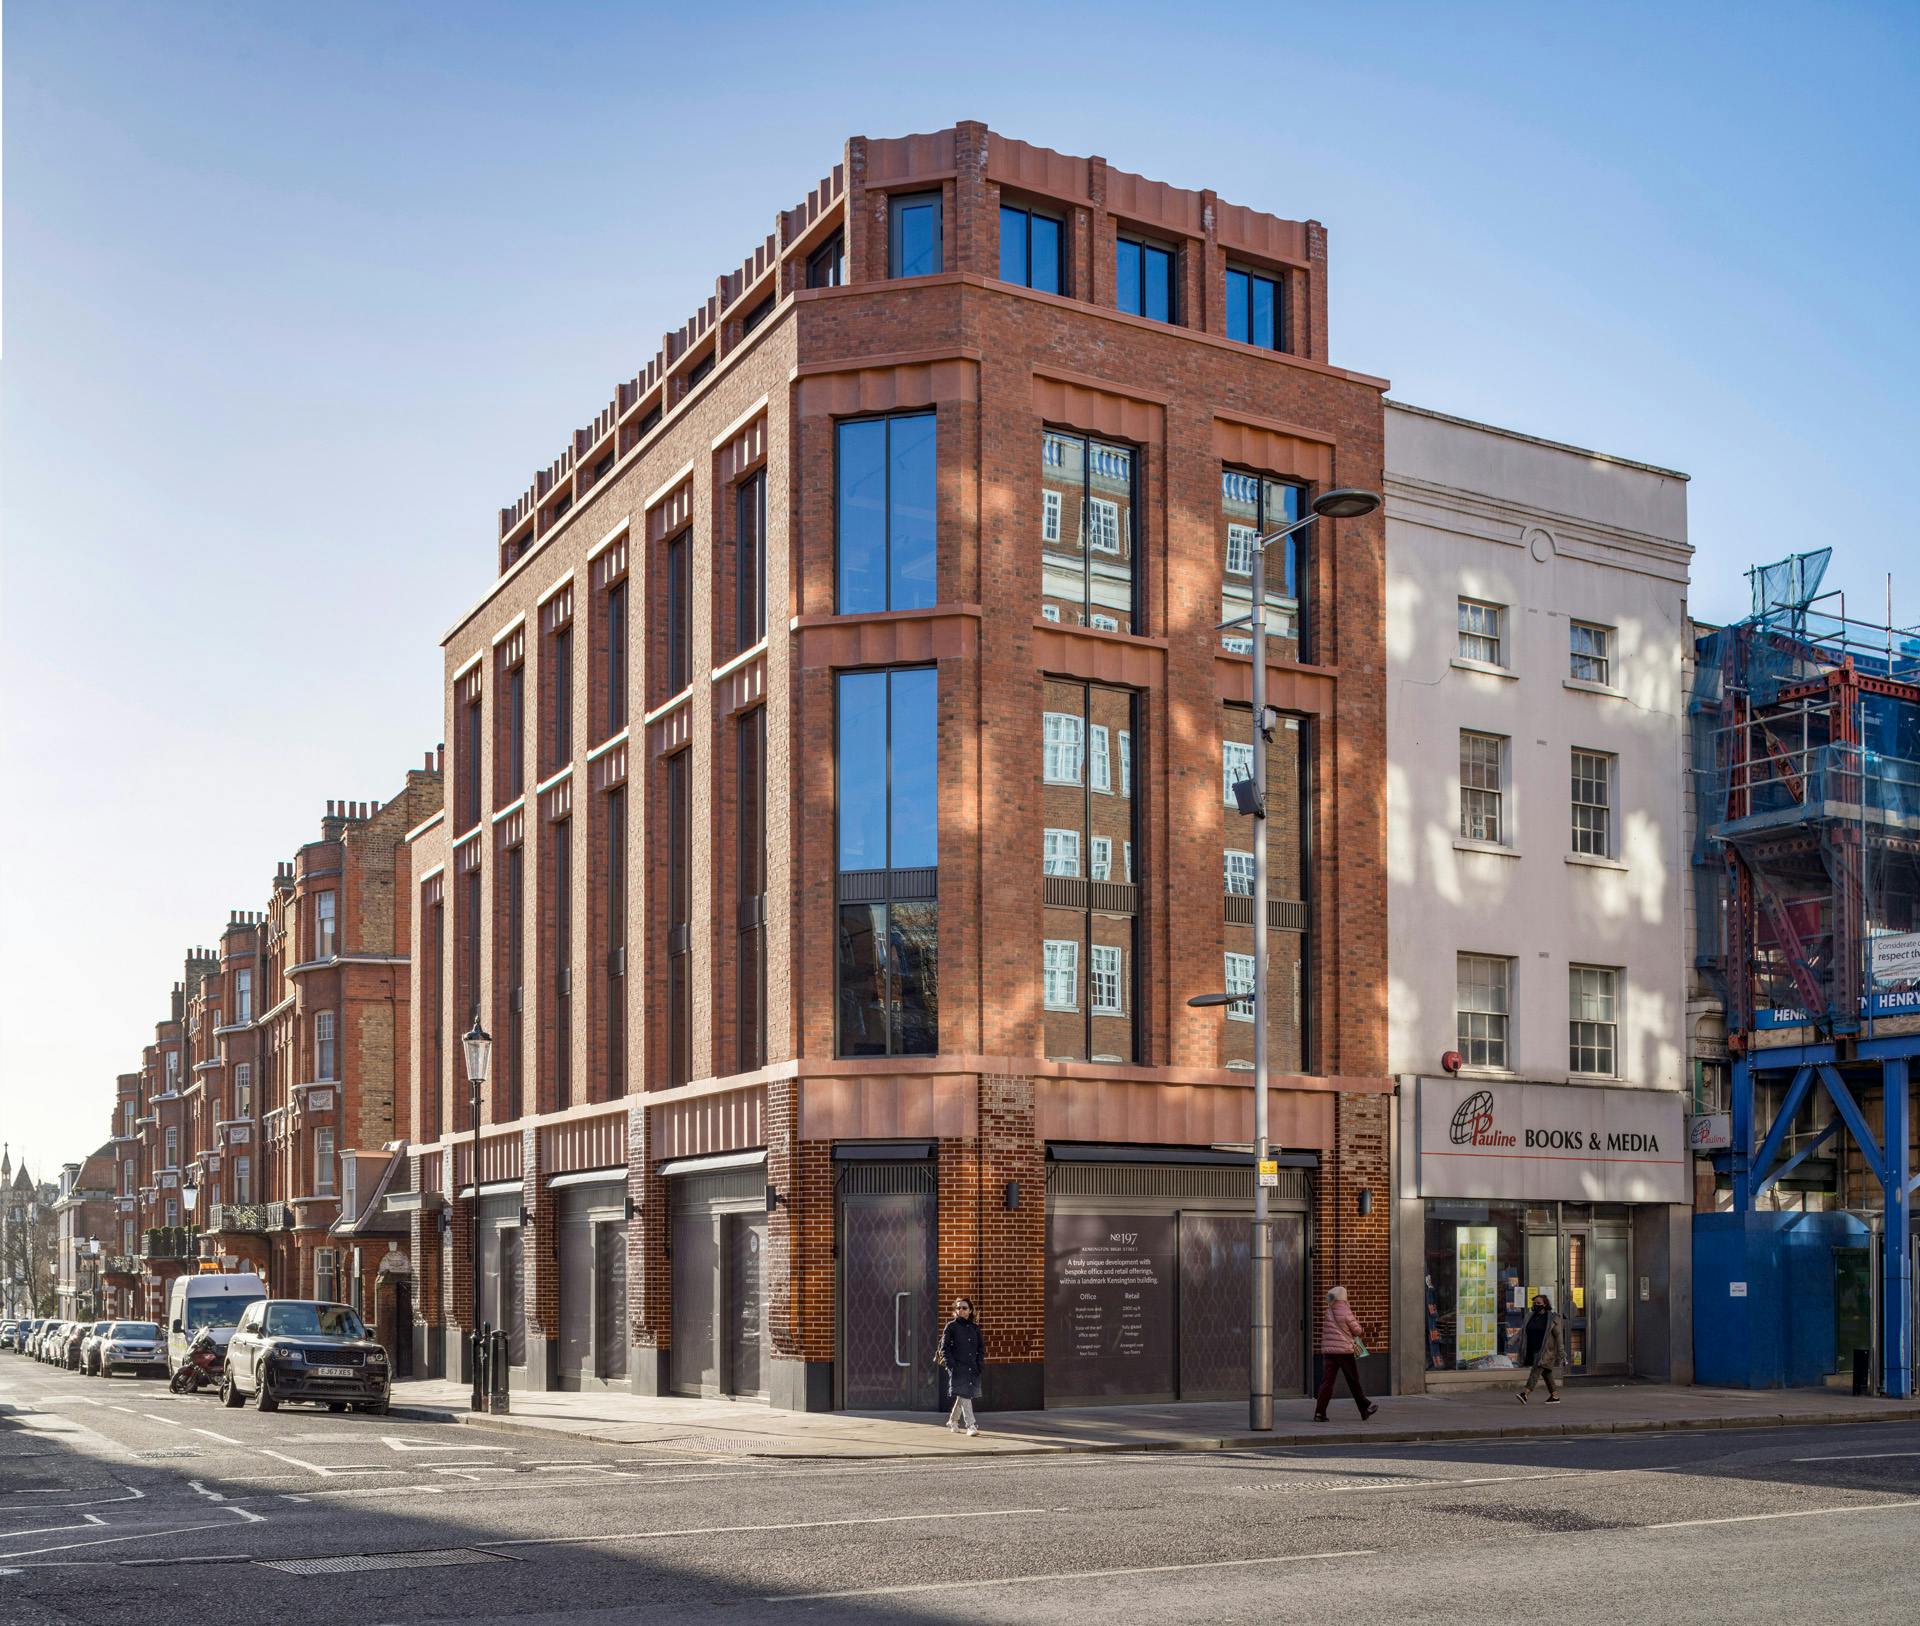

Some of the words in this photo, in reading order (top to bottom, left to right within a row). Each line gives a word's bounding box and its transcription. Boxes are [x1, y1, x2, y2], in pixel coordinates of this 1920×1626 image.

[1877, 941, 1916, 950] Considerate
[1878, 950, 1909, 962] respect
[1774, 1008, 1808, 1022] HENR
[1468, 1113, 1517, 1147] Pauline
[1525, 1129, 1583, 1150] BOOKS
[1589, 1132, 1601, 1150] &
[1606, 1133, 1660, 1152] MEDIA
[1073, 1259, 1086, 1267] truly
[1086, 1259, 1105, 1267] unique
[1105, 1259, 1139, 1267] development
[1064, 1268, 1087, 1276] bespoke
[1060, 1277, 1077, 1285] within
[1081, 1277, 1106, 1285] landmark
[1107, 1277, 1137, 1286] Kensington
[1124, 1292, 1140, 1300] Retail
